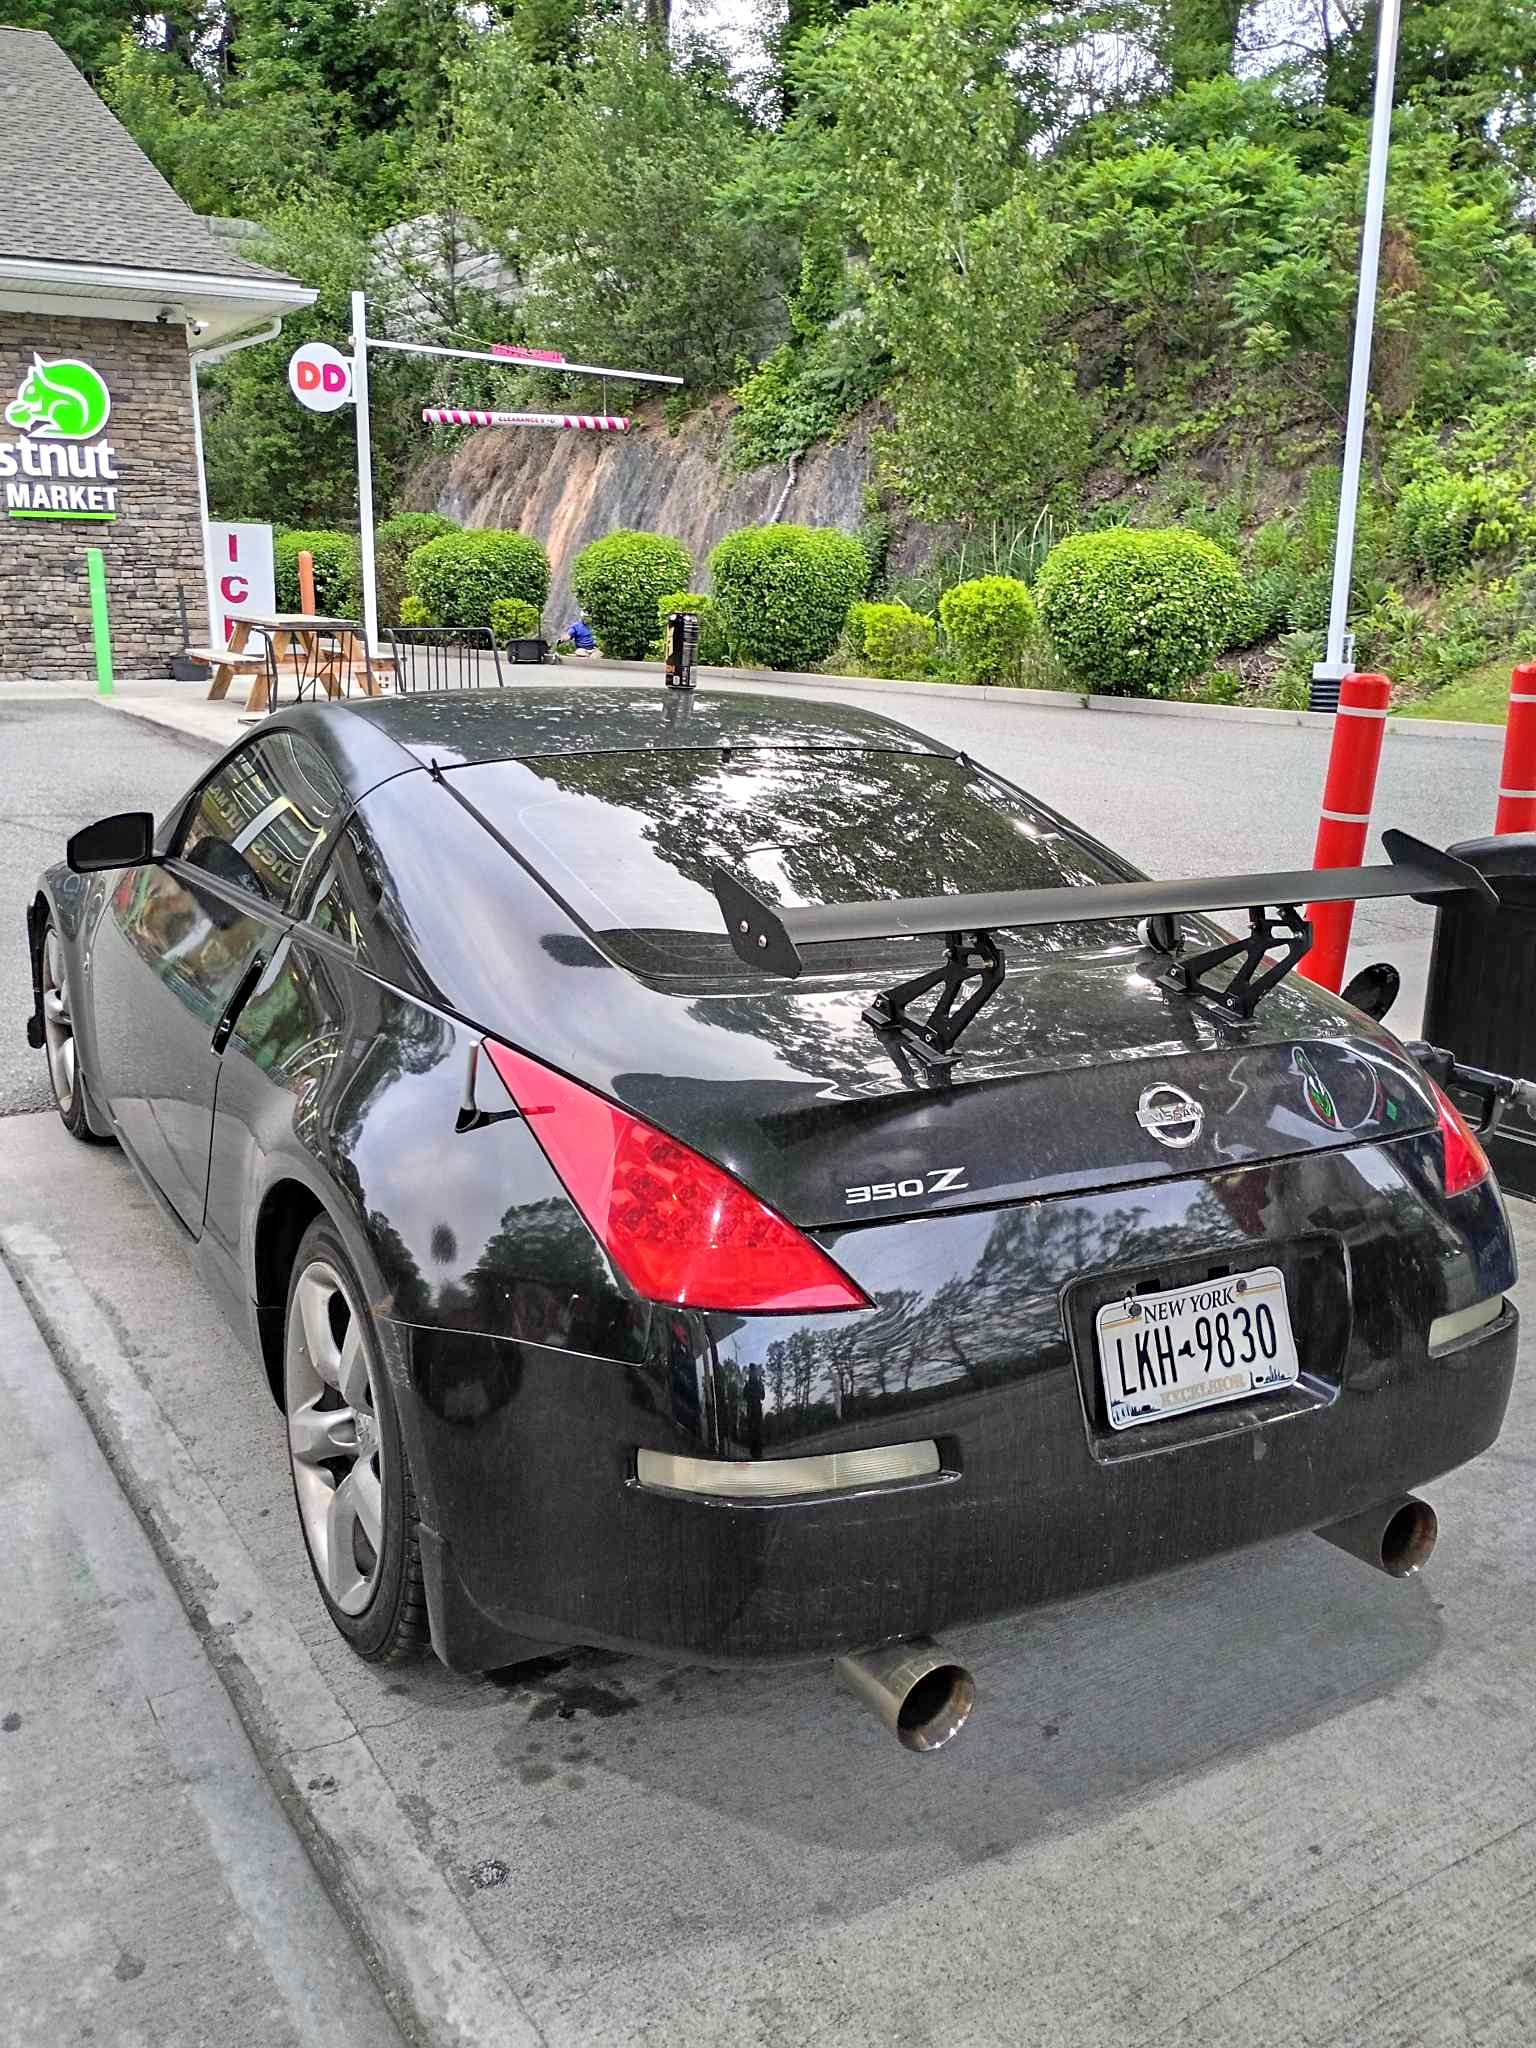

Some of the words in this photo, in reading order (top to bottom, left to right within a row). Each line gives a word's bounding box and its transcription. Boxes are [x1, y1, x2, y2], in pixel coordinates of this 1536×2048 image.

[297, 361, 346, 392] DD
[6, 483, 118, 511] MARKET
[1150, 1105, 1201, 1122] NISSAN
[845, 1166, 969, 1205] 350Z
[1144, 1300, 1185, 1324] NEW
[1190, 1287, 1236, 1313] YORK
